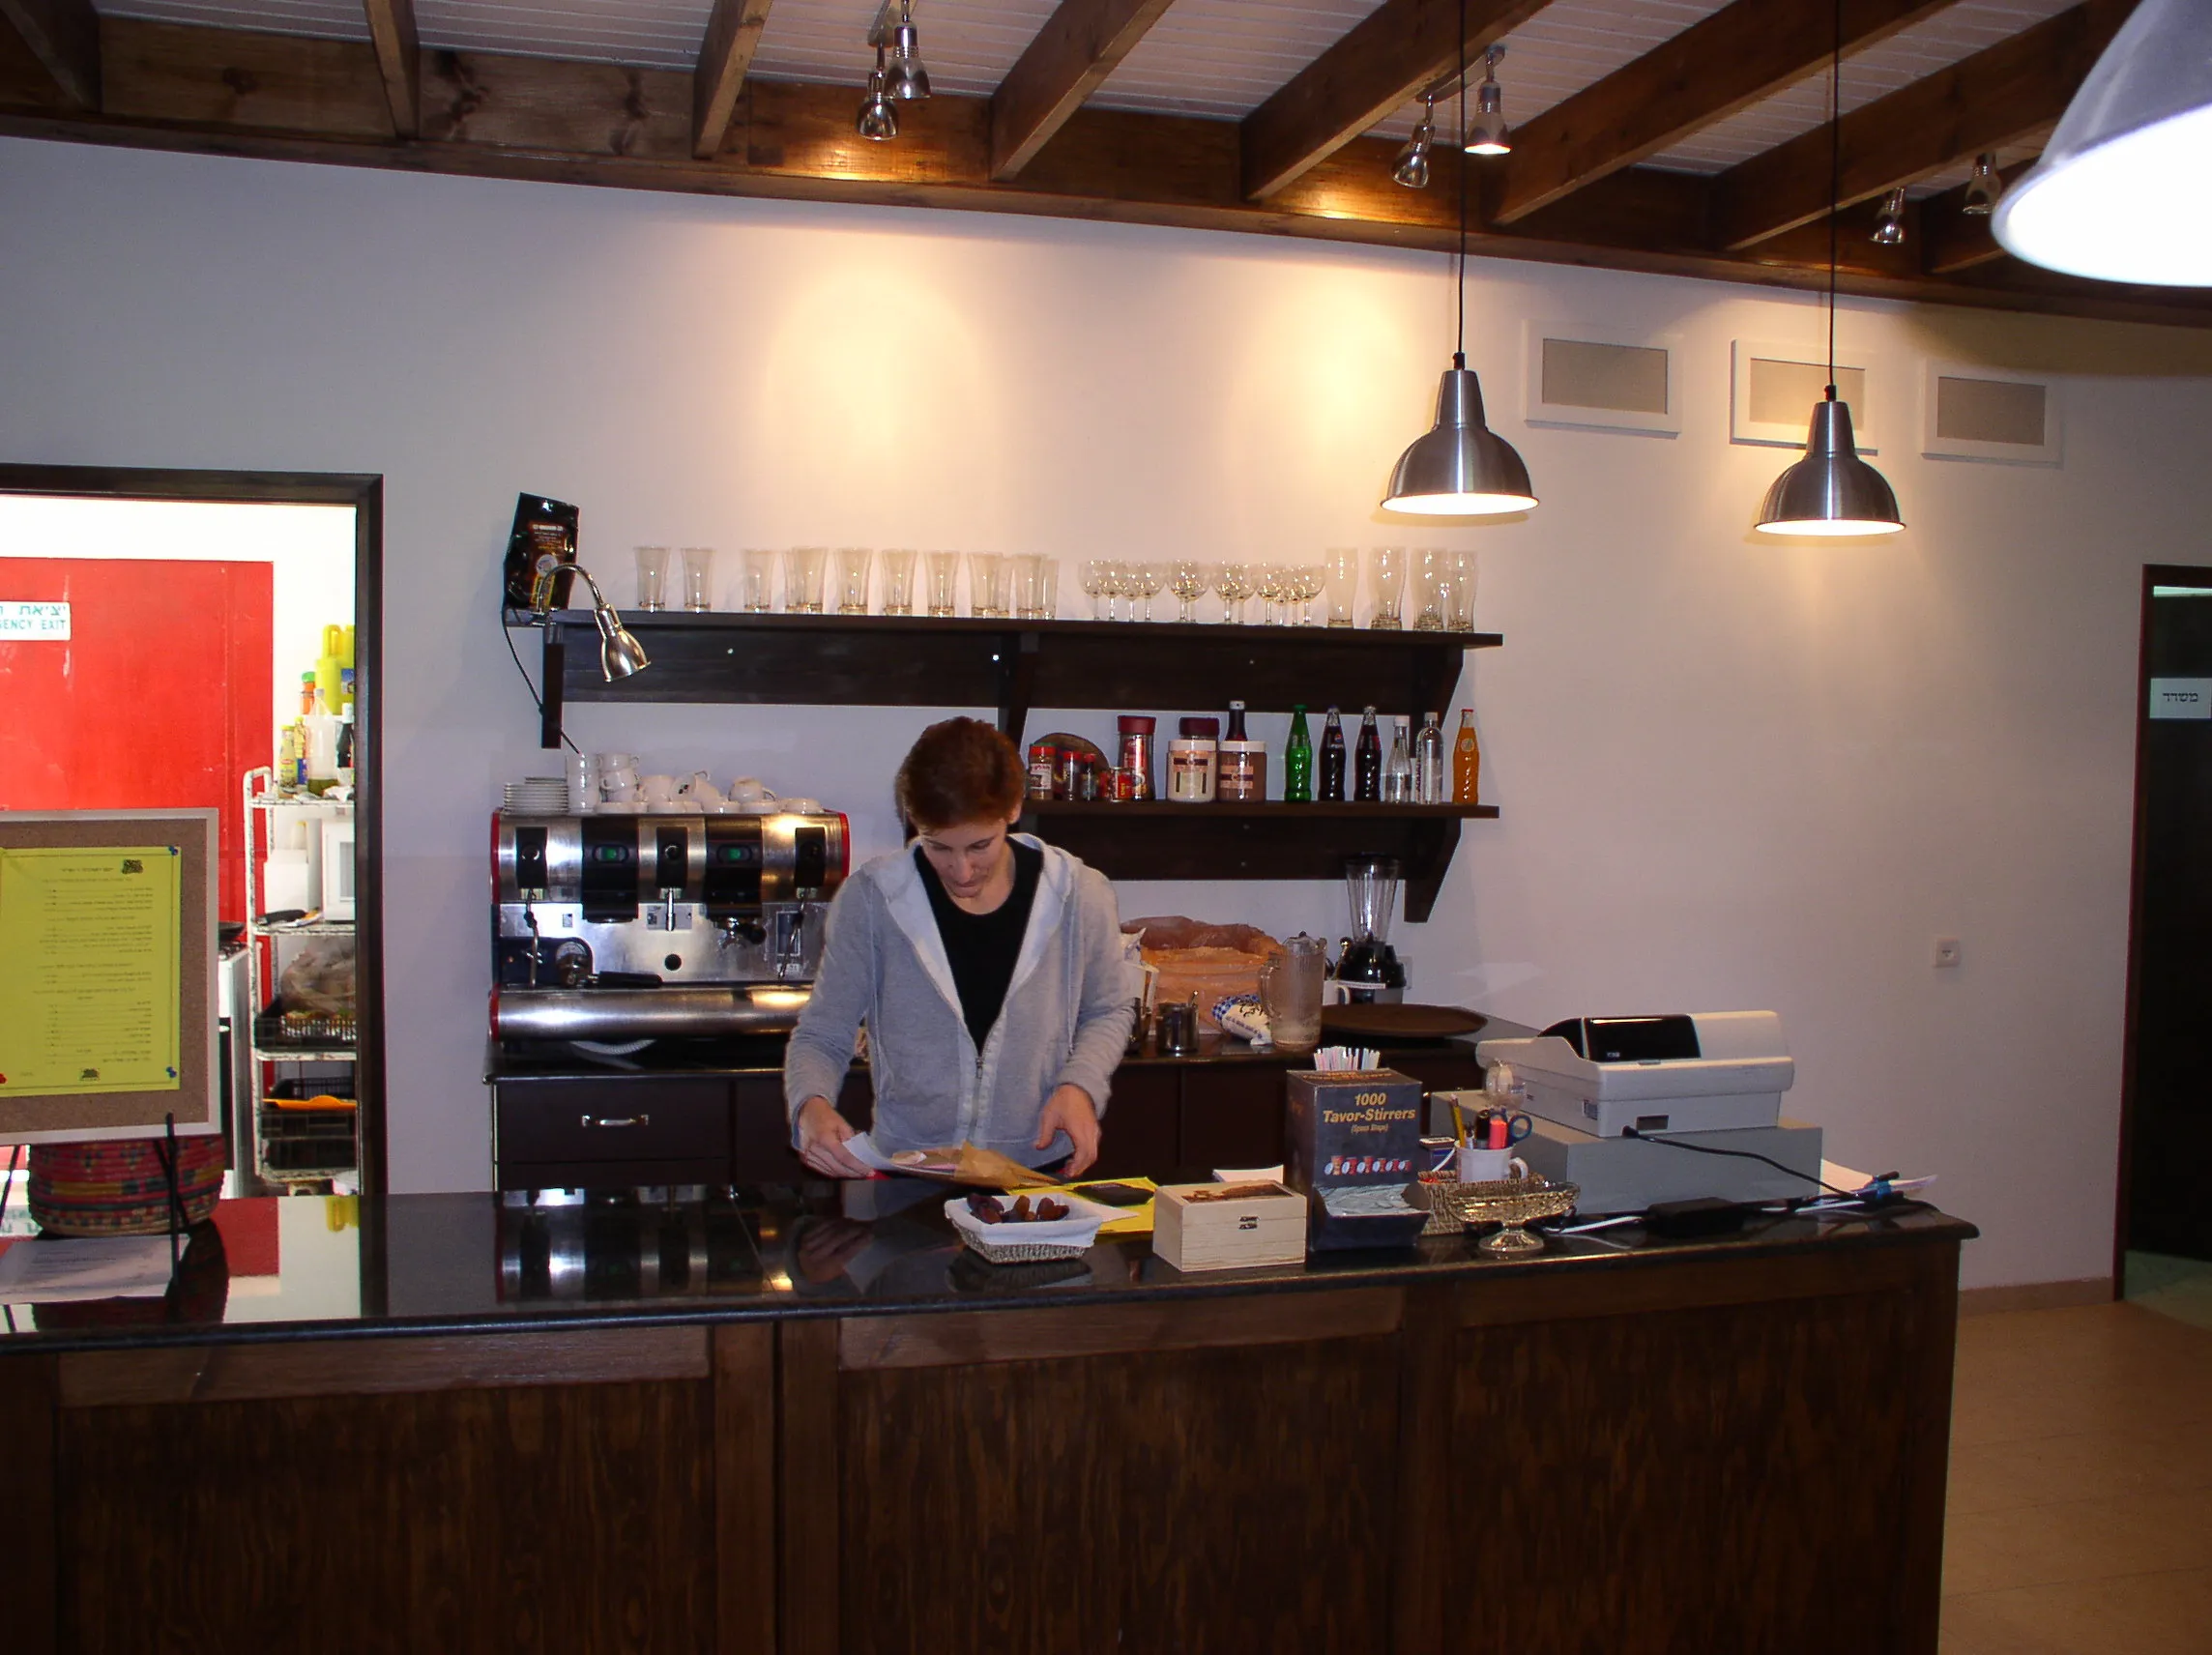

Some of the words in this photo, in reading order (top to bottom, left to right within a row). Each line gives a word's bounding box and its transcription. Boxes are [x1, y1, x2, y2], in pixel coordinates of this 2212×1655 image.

[18, 605, 66, 616] יציאת
[42, 620, 66, 630] EXIT
[2162, 692, 2197, 702] משרד
[1354, 1092, 1386, 1106] 1000
[1323, 1108, 1416, 1123] Tavor-Stirrers
